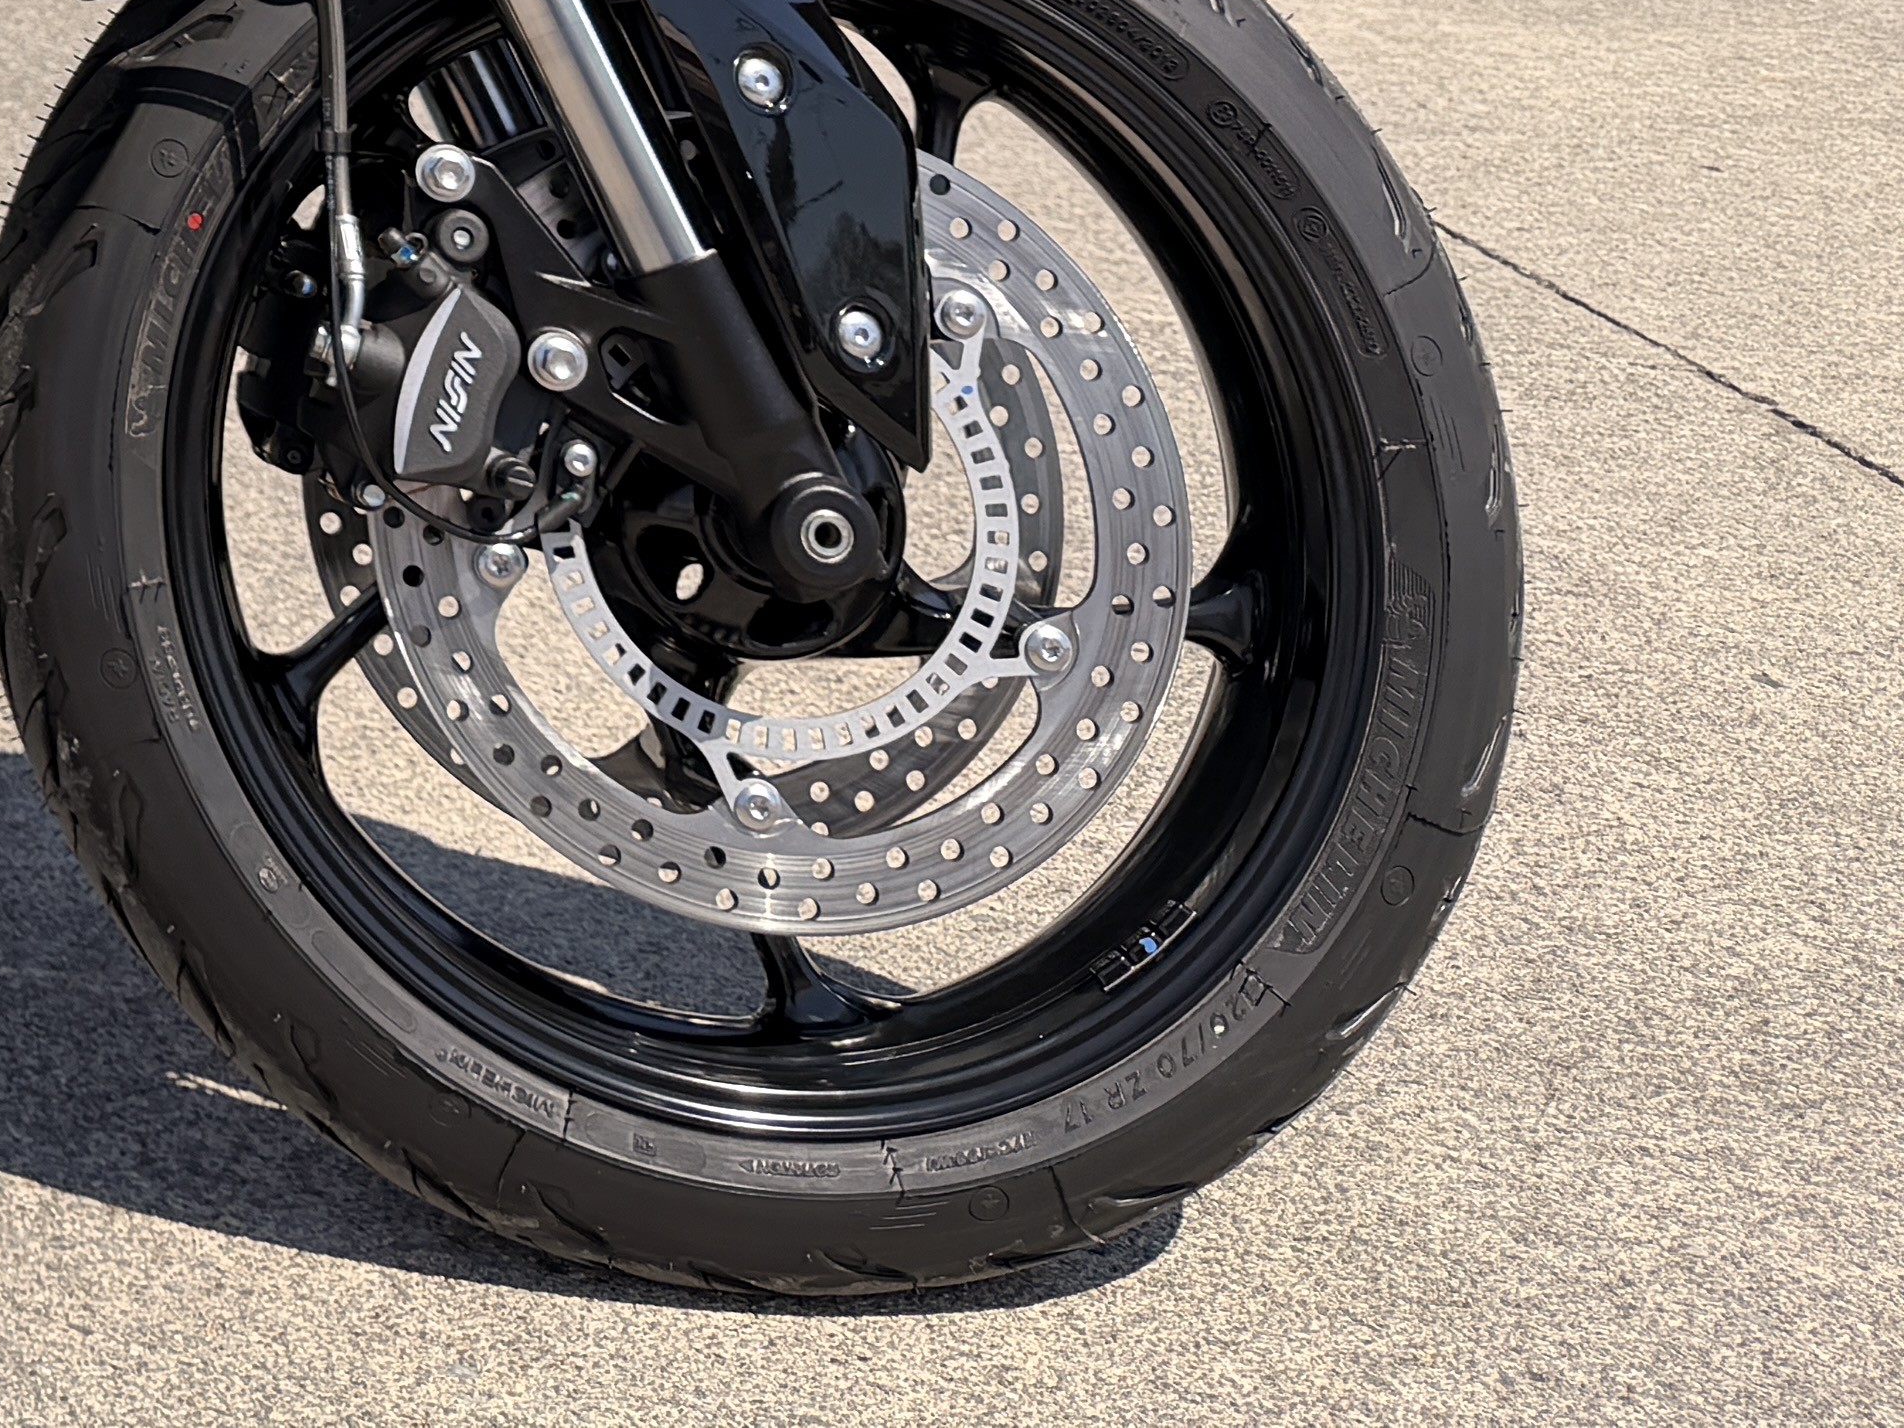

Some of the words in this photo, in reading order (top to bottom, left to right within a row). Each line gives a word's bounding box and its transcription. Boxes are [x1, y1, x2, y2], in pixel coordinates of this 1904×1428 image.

[1286, 656, 1420, 945] MICHELIN
[1104, 1069, 1148, 1110] ZR
[1064, 1099, 1093, 1135] 17
